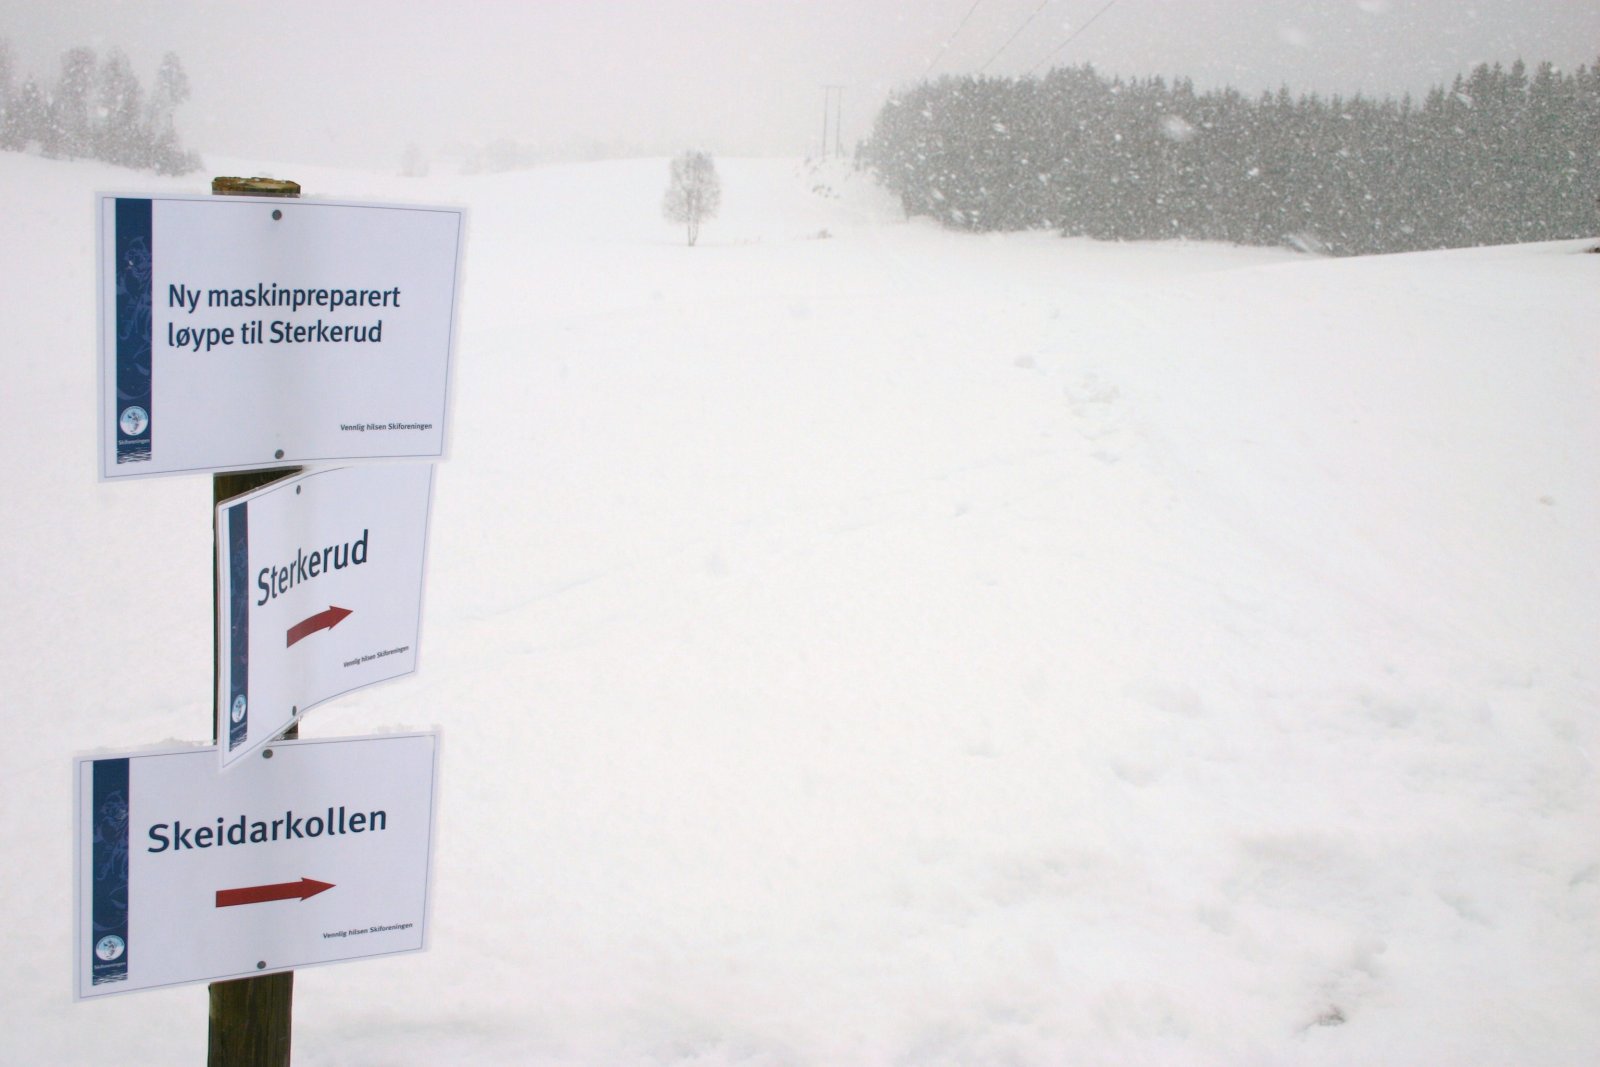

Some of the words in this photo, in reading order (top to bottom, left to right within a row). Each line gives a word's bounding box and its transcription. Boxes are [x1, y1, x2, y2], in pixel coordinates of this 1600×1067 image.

[168, 284, 201, 313] Ny
[208, 283, 401, 312] maskinpreparert
[168, 322, 235, 352] løype
[241, 321, 263, 345] til
[270, 319, 382, 344] Sterkerud
[340, 424, 365, 432] Vennlig
[366, 423, 387, 431] hilsen
[388, 422, 433, 431] Skiforeningen
[257, 529, 369, 606] Sterkerud
[148, 806, 387, 853] Skeidarkollen
[323, 930, 347, 939] Vennlig
[348, 928, 369, 936] hilsen
[369, 922, 413, 933] Skiforeningen
